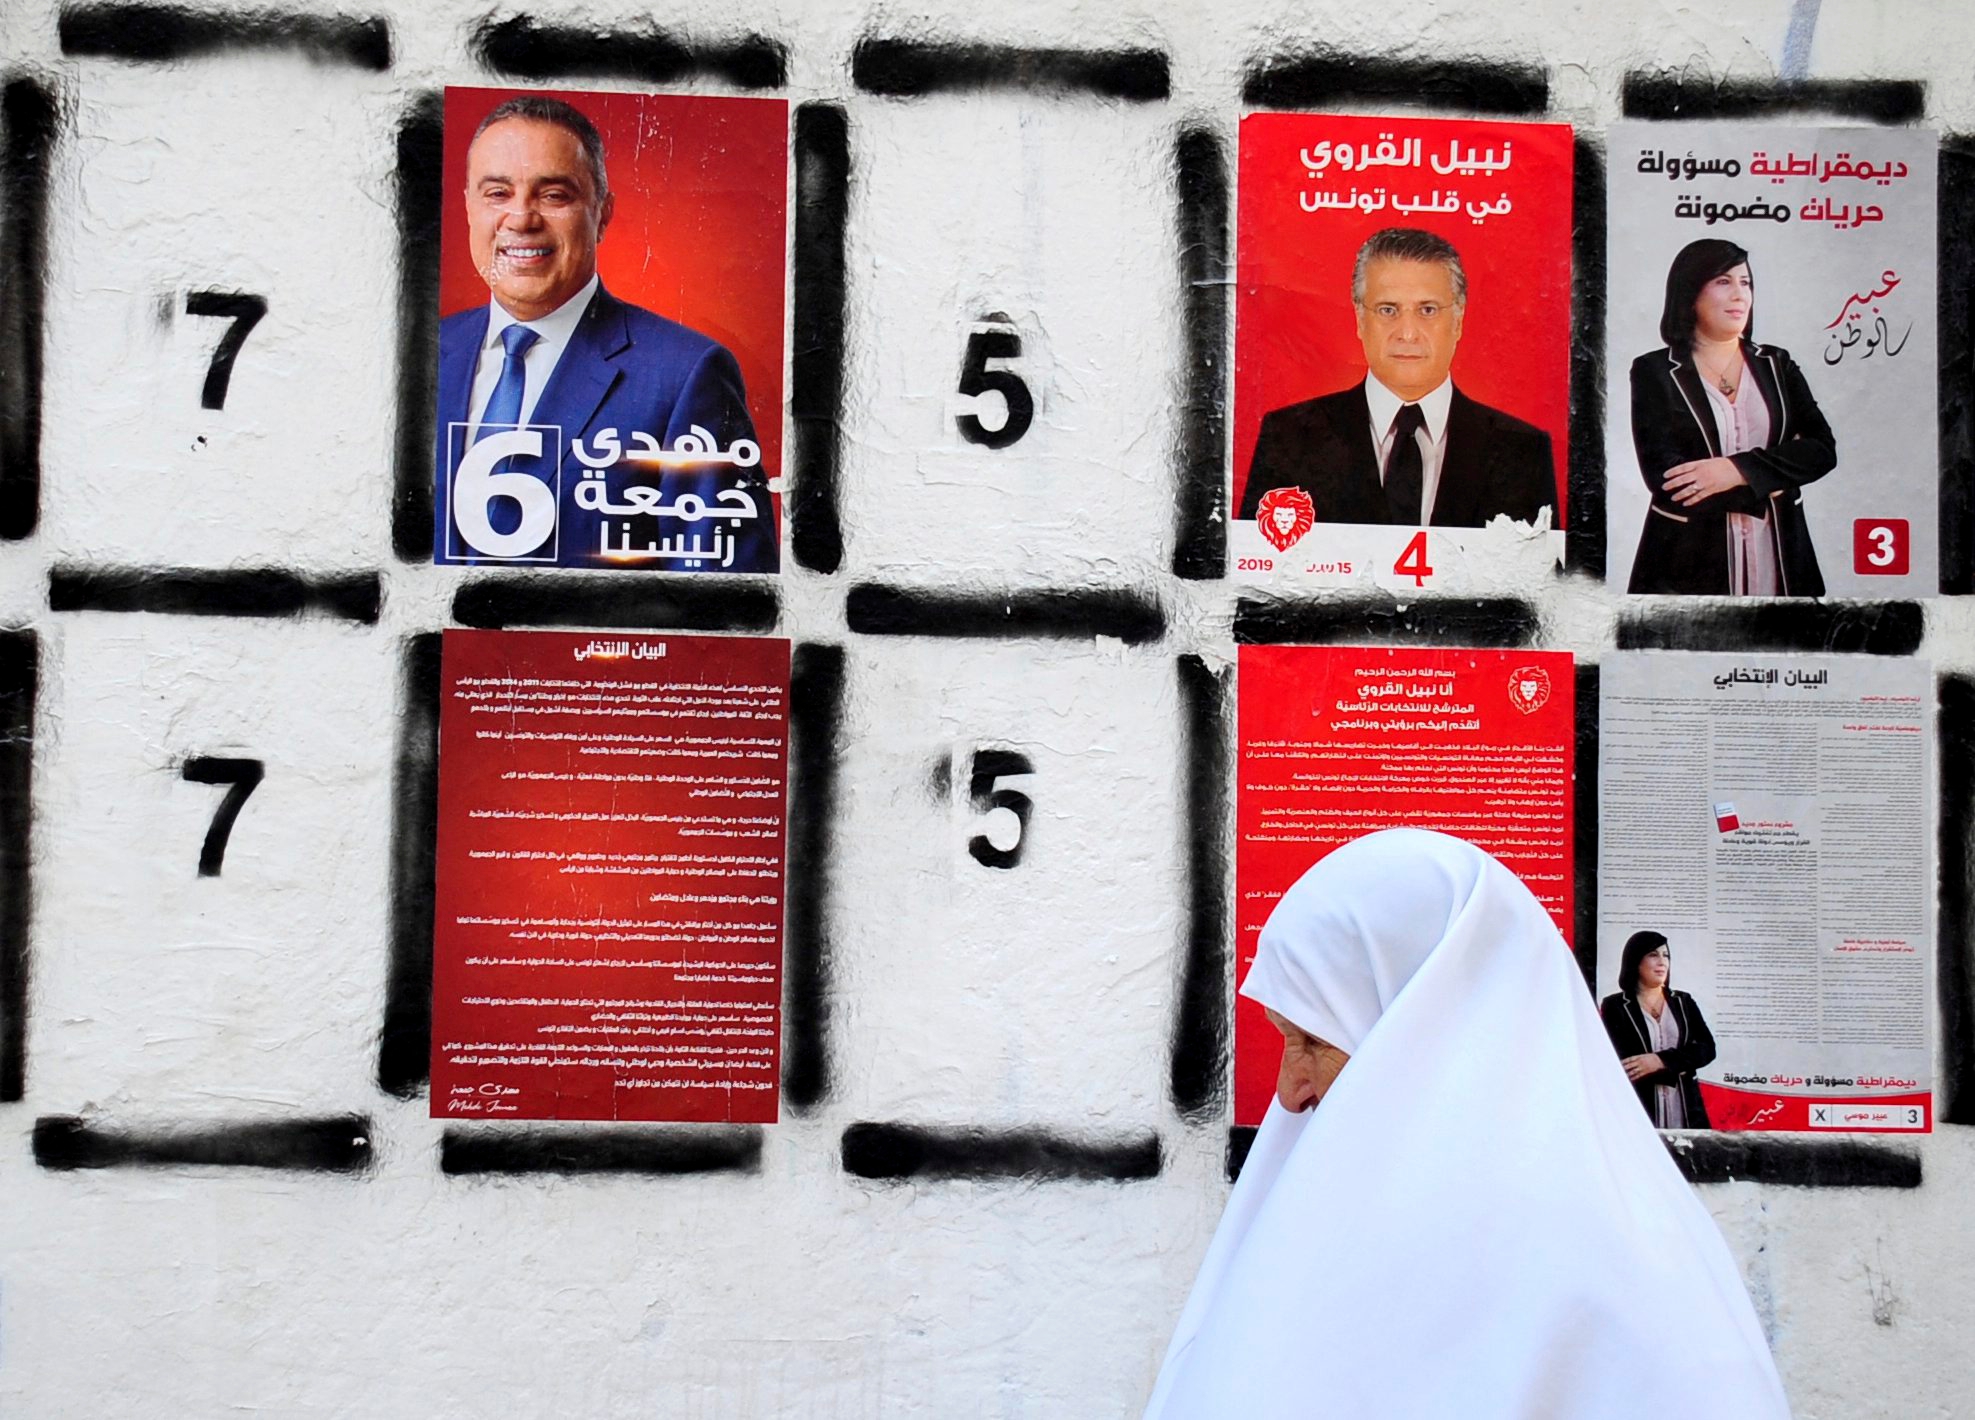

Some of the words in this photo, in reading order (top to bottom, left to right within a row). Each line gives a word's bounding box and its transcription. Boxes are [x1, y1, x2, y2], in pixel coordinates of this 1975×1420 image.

[1300, 133, 1421, 179] القروي
[1431, 139, 1513, 177] نبيل
[1637, 150, 1741, 180] مسؤولة
[1749, 152, 1908, 185] ديمقراطية
[1299, 188, 1386, 215] تونس
[1391, 190, 1460, 216] قلب
[1466, 191, 1512, 224] في
[1675, 195, 1790, 225] مضمونة
[1799, 198, 1884, 229] حريات
[1824, 270, 1901, 330] عبير
[186, 292, 269, 410] 7
[956, 318, 1033, 448] 5
[453, 430, 556, 557] 6
[574, 469, 759, 528] جمعة
[600, 521, 735, 568] رئيسنا
[1867, 527, 1896, 567] 3
[1237, 558, 1273, 571] 2019
[1337, 562, 1352, 574] 15
[1393, 531, 1434, 587] 4
[632, 642, 667, 660] البيان
[1354, 667, 1385, 677] الرحيم
[1386, 667, 1416, 678] الرحمن
[1418, 667, 1433, 677] الله
[1434, 668, 1456, 678] بسم
[1713, 668, 1779, 690] الإنتخابي
[1784, 669, 1828, 690] البيان
[1357, 681, 1403, 700] القروي
[1406, 683, 1436, 698] نبيل
[1439, 681, 1453, 696] أنا
[1380, 701, 1431, 713] للانتخابات
[1330, 718, 1380, 732] وبرنامجي
[1381, 719, 1414, 733] برؤيتي
[184, 758, 264, 877] 7
[970, 750, 1034, 869] 5
[1723, 1073, 1767, 1085] مضمونة
[1770, 1074, 1802, 1088] حريات
[1805, 1077, 1811, 1087] و
[1813, 1075, 1854, 1088] مسؤولة
[1856, 1076, 1917, 1089] ديمقراطية
[1815, 1109, 1826, 1122] X
[1908, 1109, 1918, 1124] 3
